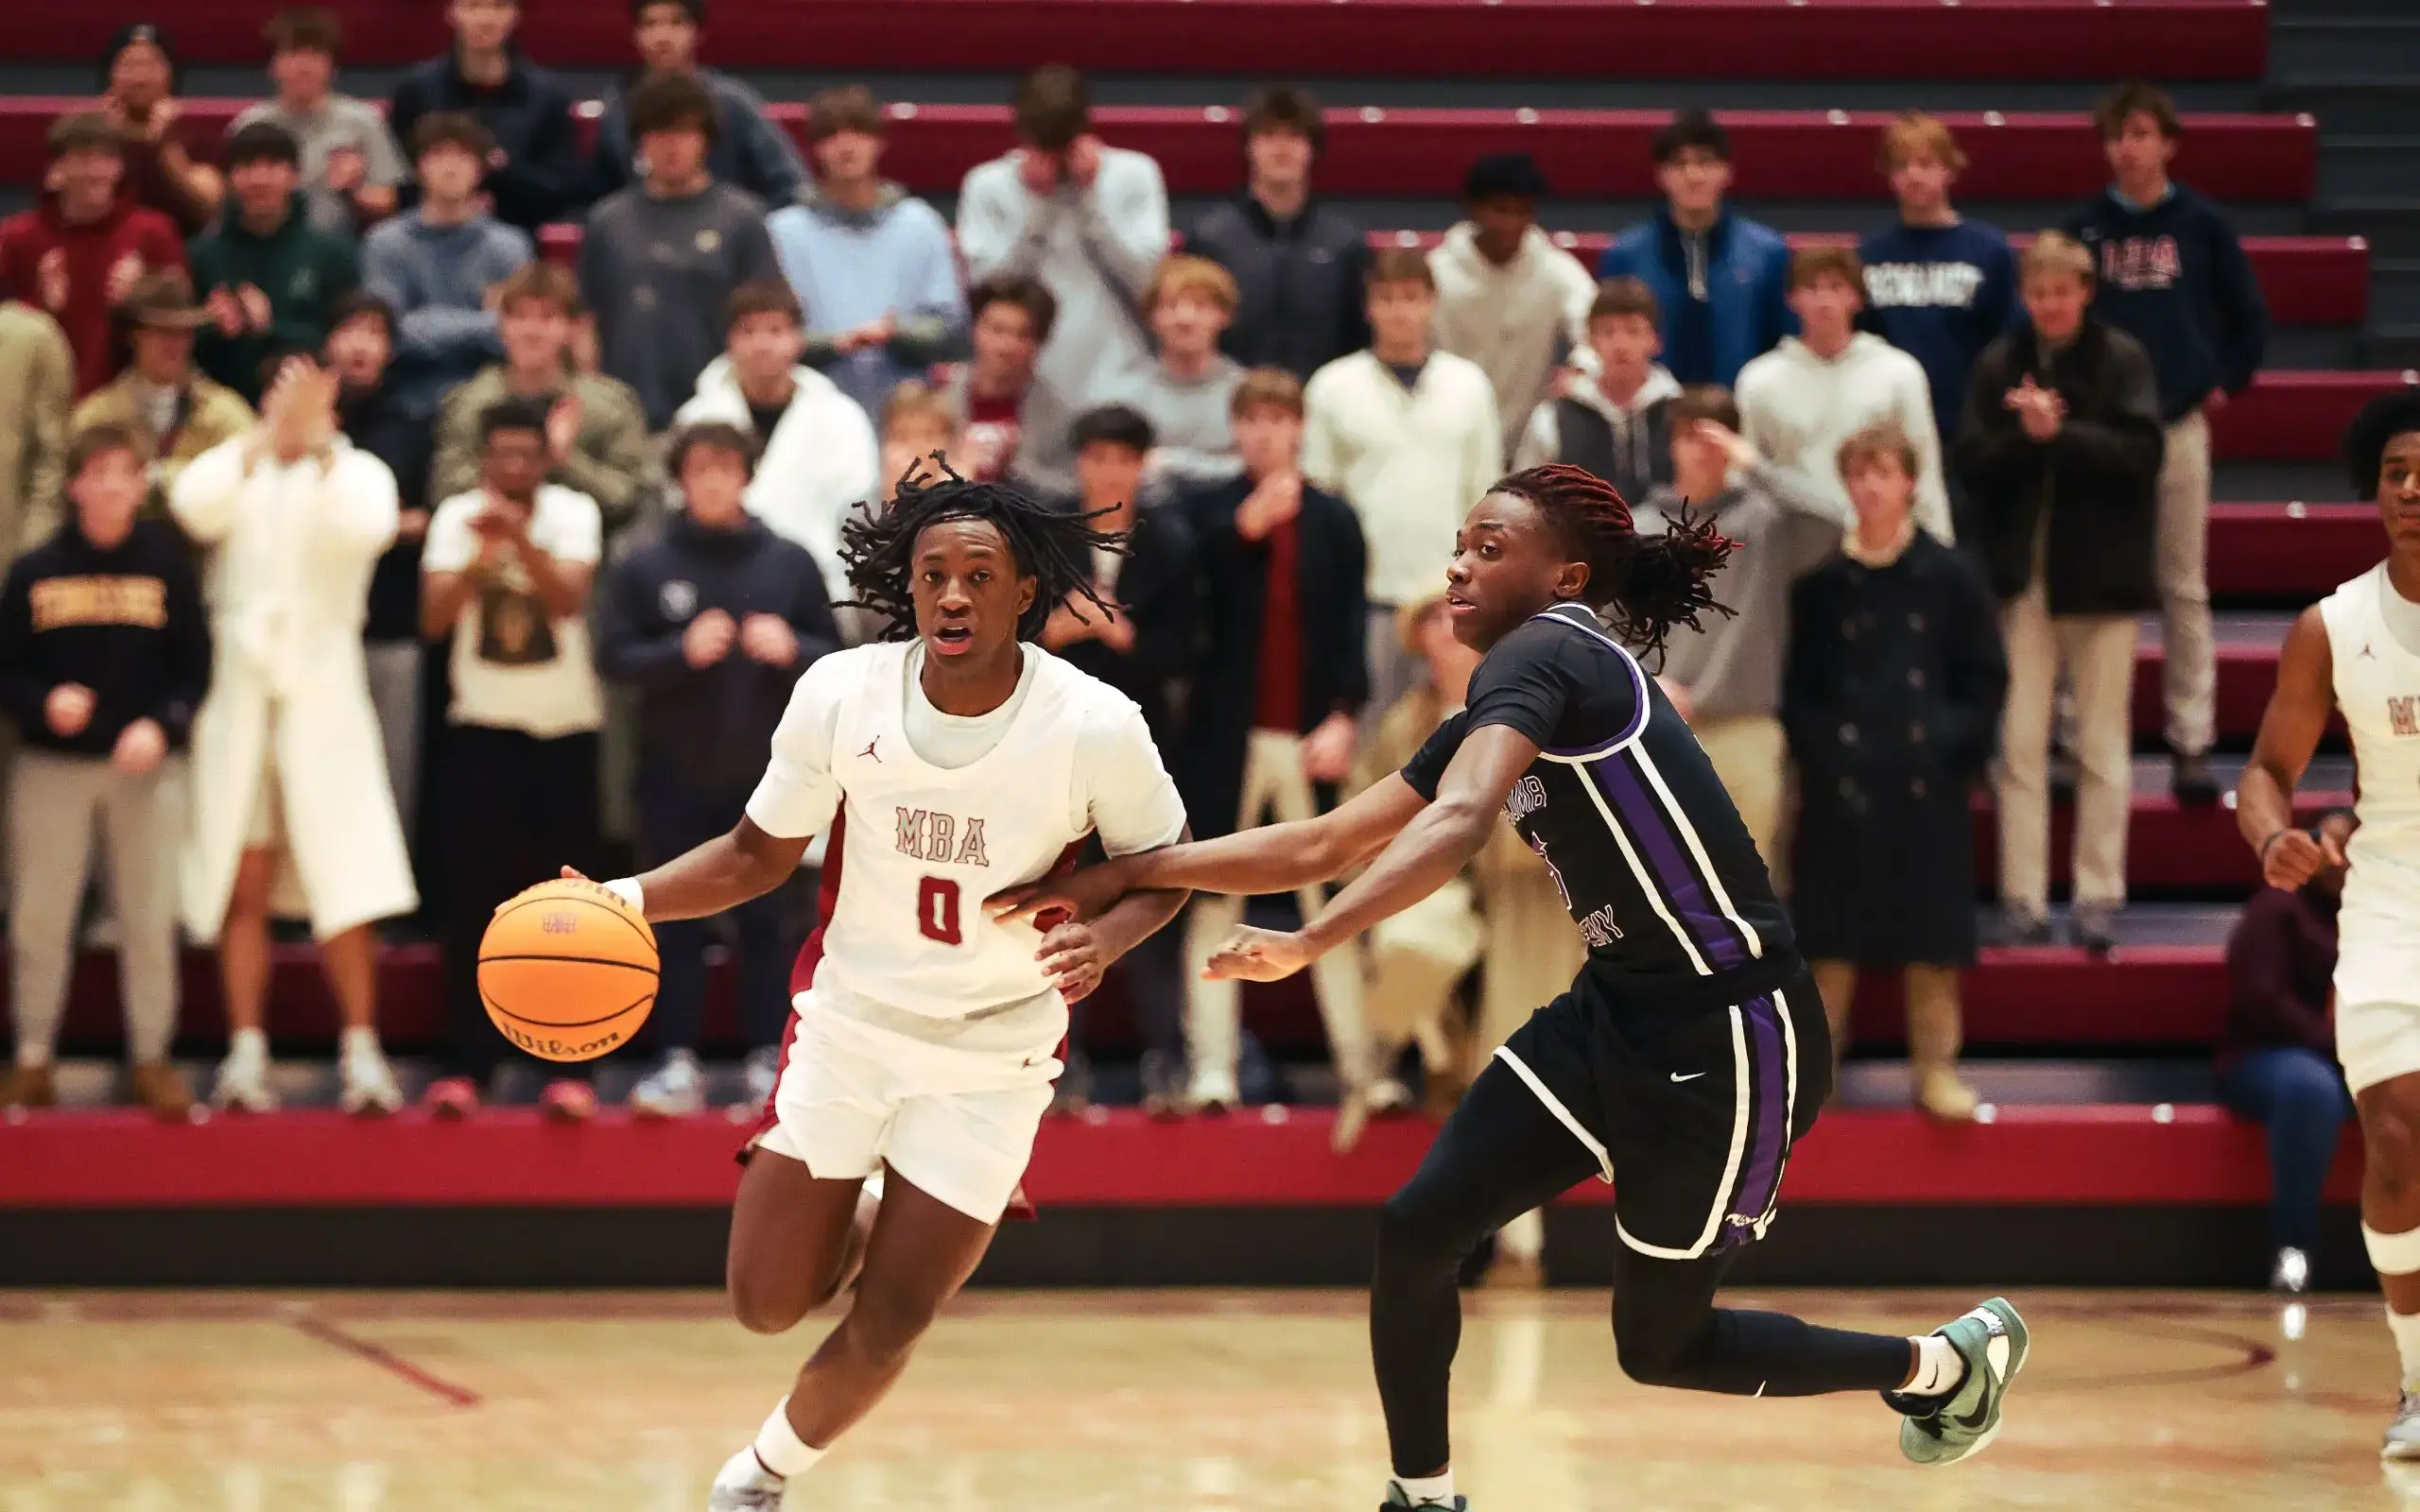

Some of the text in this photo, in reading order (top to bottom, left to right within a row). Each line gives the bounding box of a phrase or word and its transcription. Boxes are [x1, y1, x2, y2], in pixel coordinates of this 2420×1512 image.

[895, 806, 989, 868] MBA
[918, 875, 963, 946] 0
[503, 1021, 619, 1055] Wilson
